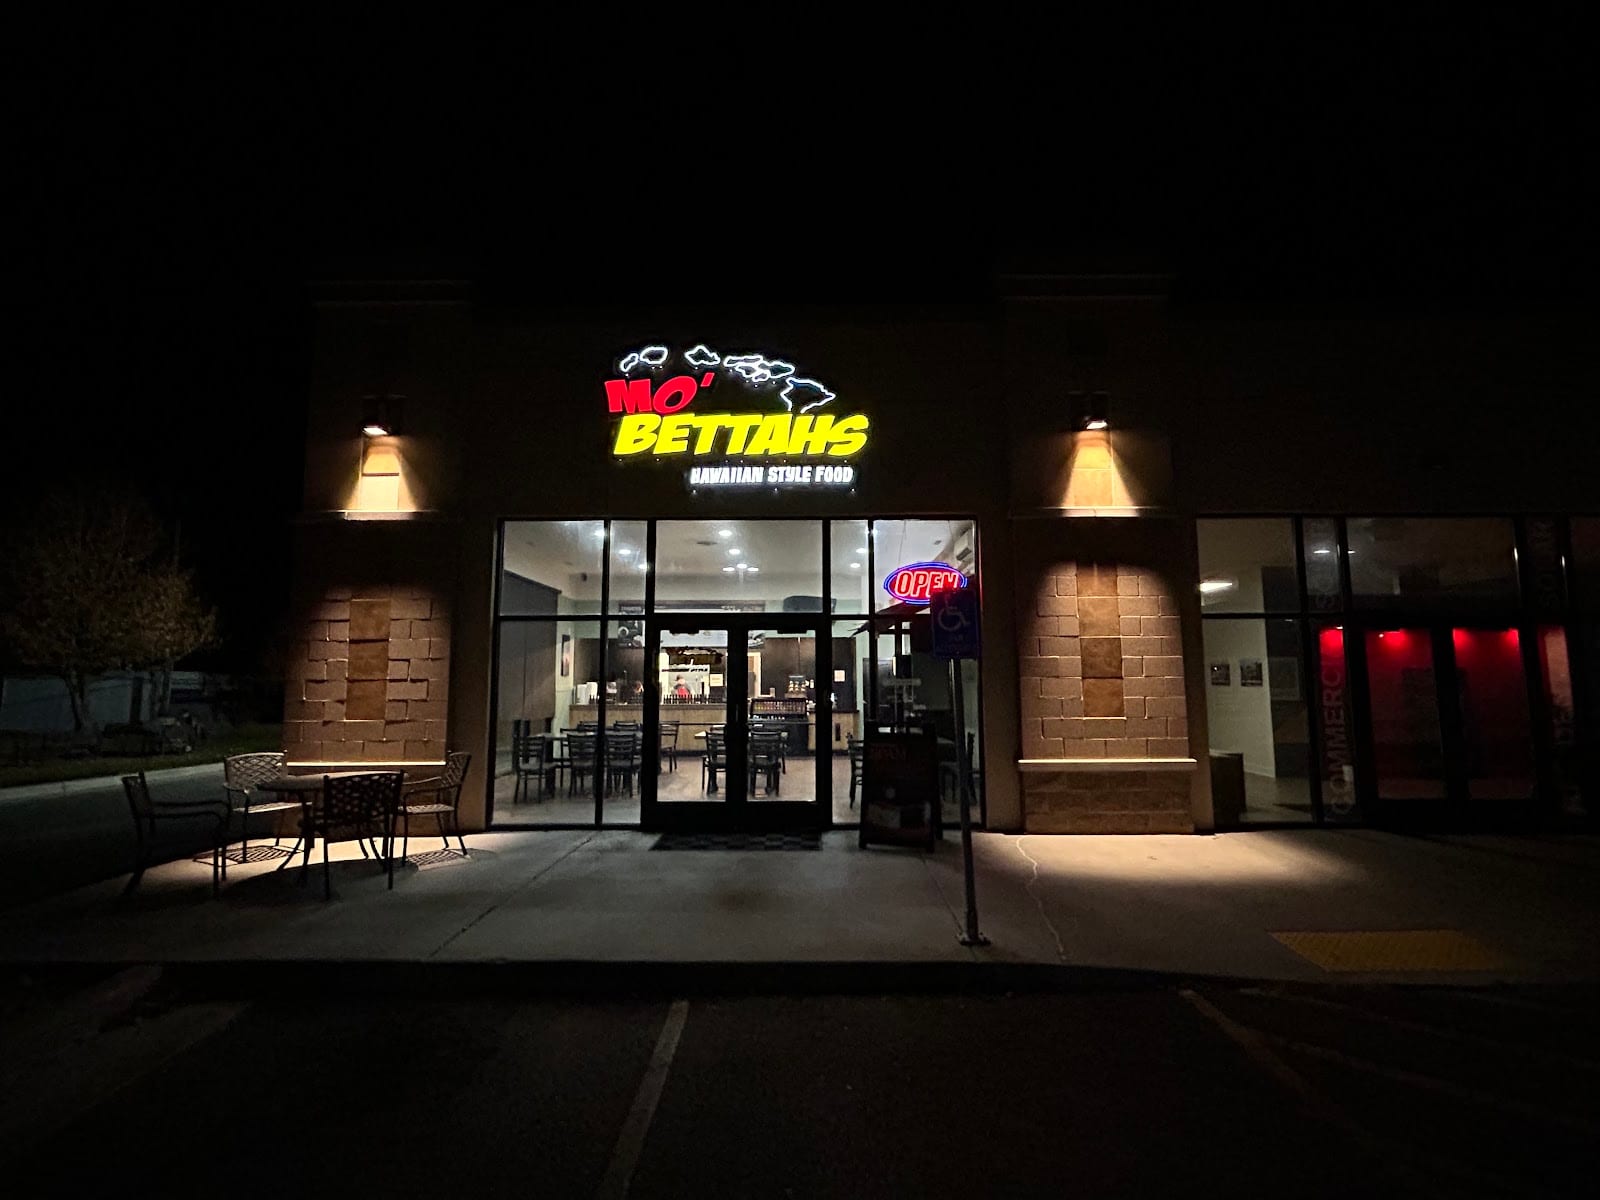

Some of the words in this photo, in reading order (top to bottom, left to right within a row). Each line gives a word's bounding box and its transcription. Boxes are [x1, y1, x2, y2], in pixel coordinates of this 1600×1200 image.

[604, 372, 715, 414] MO'
[613, 413, 869, 457] BETTAHS
[690, 466, 764, 485] HAWAIIAN
[767, 466, 812, 484] STYLE
[814, 466, 854, 484] FOOD
[895, 570, 960, 598] OPEN
